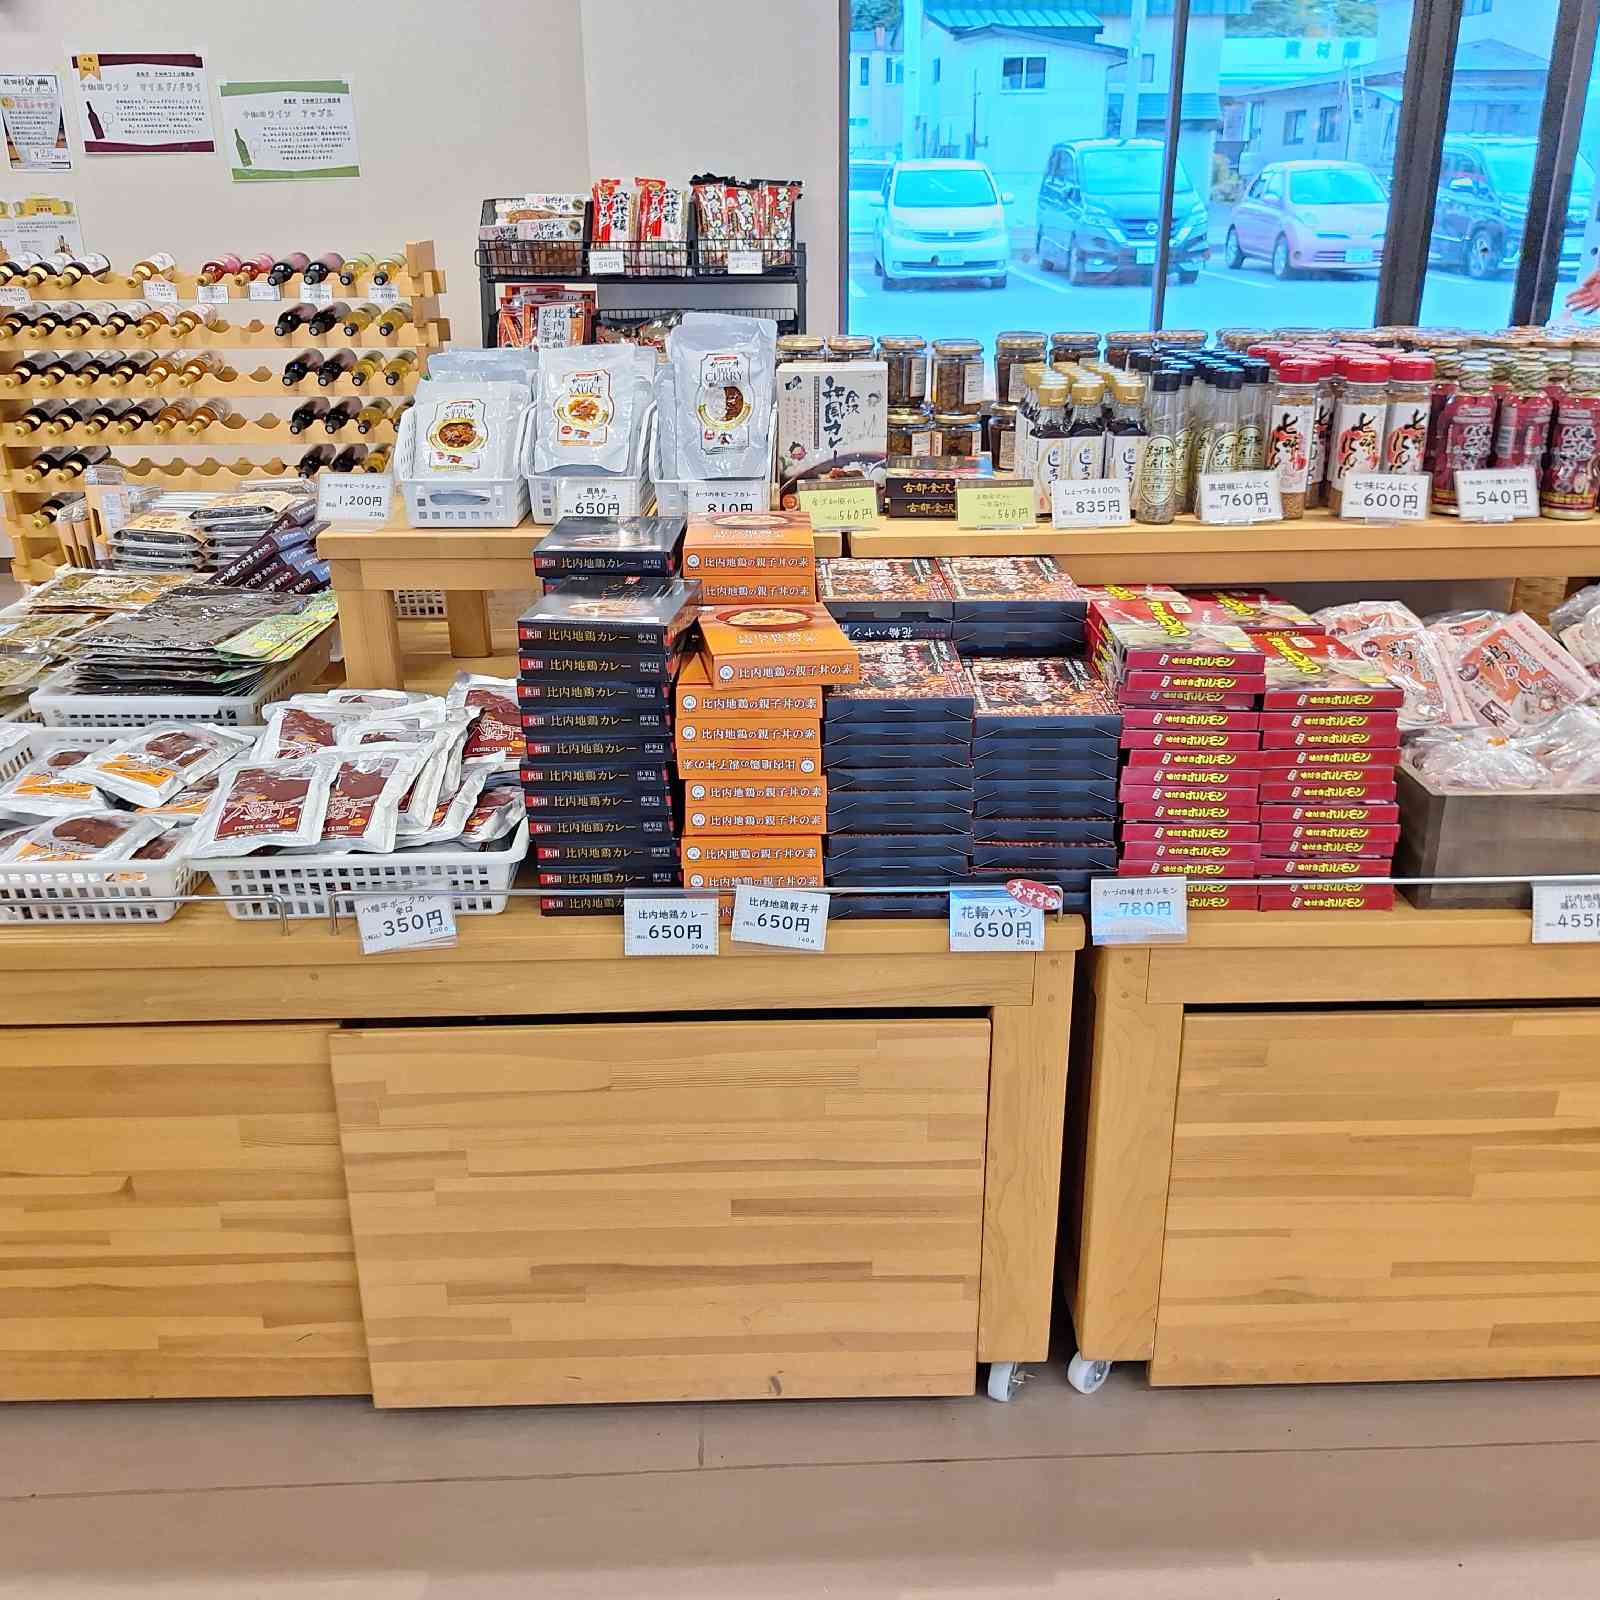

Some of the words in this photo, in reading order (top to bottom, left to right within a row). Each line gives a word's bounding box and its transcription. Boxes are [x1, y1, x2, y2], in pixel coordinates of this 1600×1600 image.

[1353, 480, 1419, 492] 七味にんにく
[339, 495, 382, 507] 1,200円
[1220, 491, 1269, 507] 760円
[1363, 493, 1418, 510] 600円
[1475, 489, 1528, 505] 540円
[575, 502, 620, 515] 650円
[707, 503, 753, 513] 810円
[1075, 500, 1121, 514] 835円
[838, 508, 874, 521] 560円
[547, 628, 631, 642] 比内地鶏カレー
[549, 658, 632, 671] 比内地鶏カレー
[546, 686, 629, 698] 比内地鶏カレー
[550, 715, 633, 727] 比内地鶏カレー
[556, 743, 637, 755] 比内地鶏カレー
[549, 769, 630, 781] 比内地鶏カレー
[553, 796, 633, 808] 比内地鶏カレー
[556, 821, 637, 833] 比内地鶏カレー
[566, 847, 643, 859] 比内地鶏カレー
[567, 872, 646, 884] 比内地鶏カレー
[1011, 880, 1059, 907] おすすめ
[1103, 887, 1178, 897] かづの味付ホルモン
[395, 905, 413, 915] 辛口
[638, 910, 709, 919] 比内地鶏カレー
[961, 905, 1032, 920] 花輪ハヤシ
[1119, 901, 1172, 916] 780円
[382, 909, 444, 937] 350円
[757, 913, 810, 933] 650円
[1558, 913, 1600, 928] 455
[648, 924, 702, 940] 650円
[973, 921, 1032, 938] 650円
